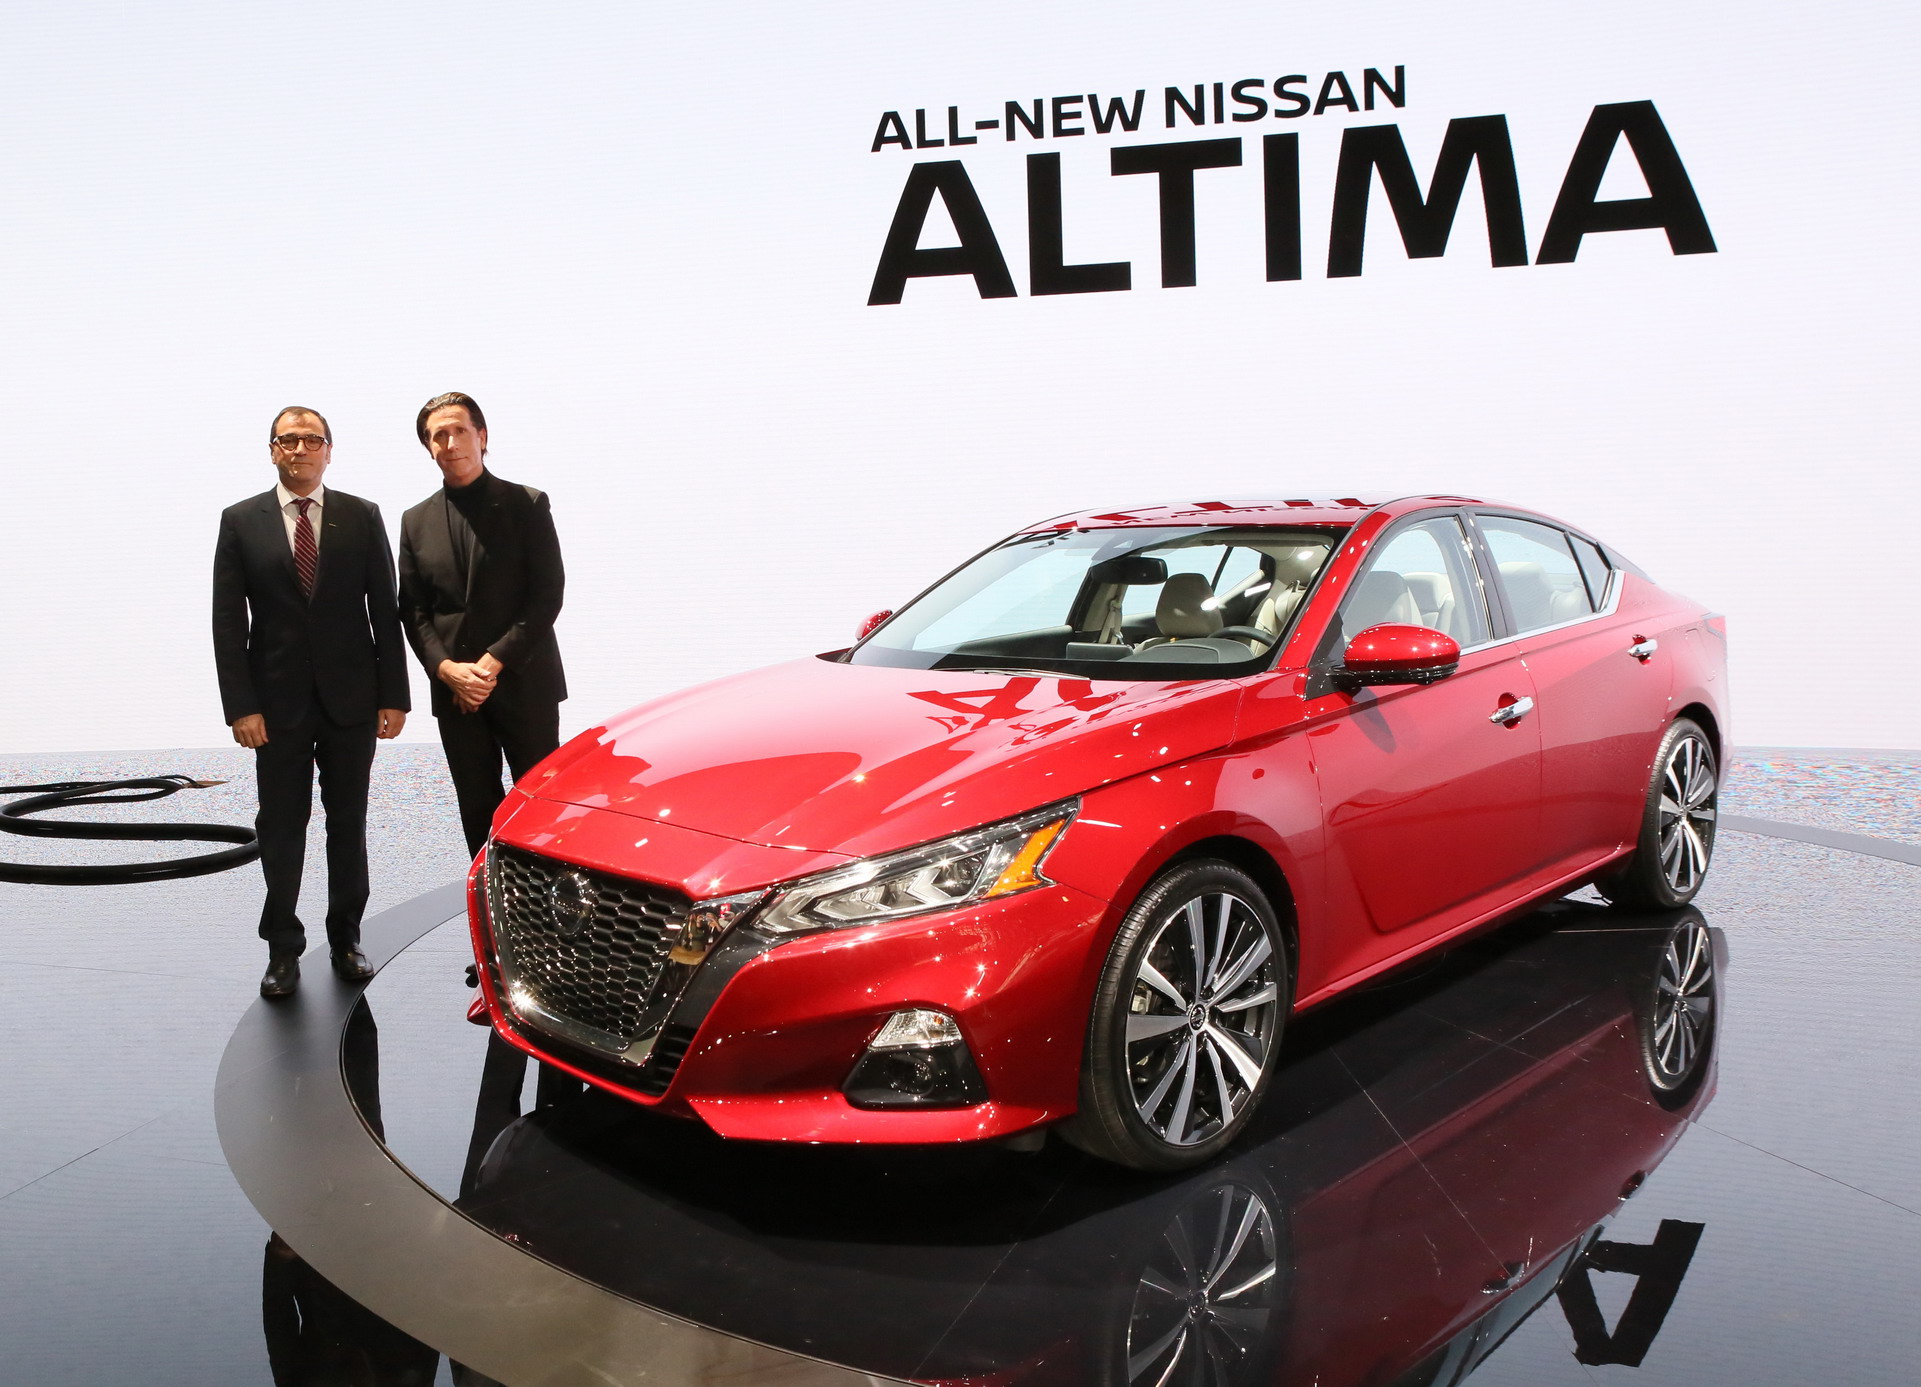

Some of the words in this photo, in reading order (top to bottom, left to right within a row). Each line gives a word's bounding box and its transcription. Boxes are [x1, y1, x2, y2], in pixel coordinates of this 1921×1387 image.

[871, 89, 1146, 153] ALL-NEW
[1165, 64, 1406, 129] NISSAN
[867, 99, 1718, 307] ALTIMA
